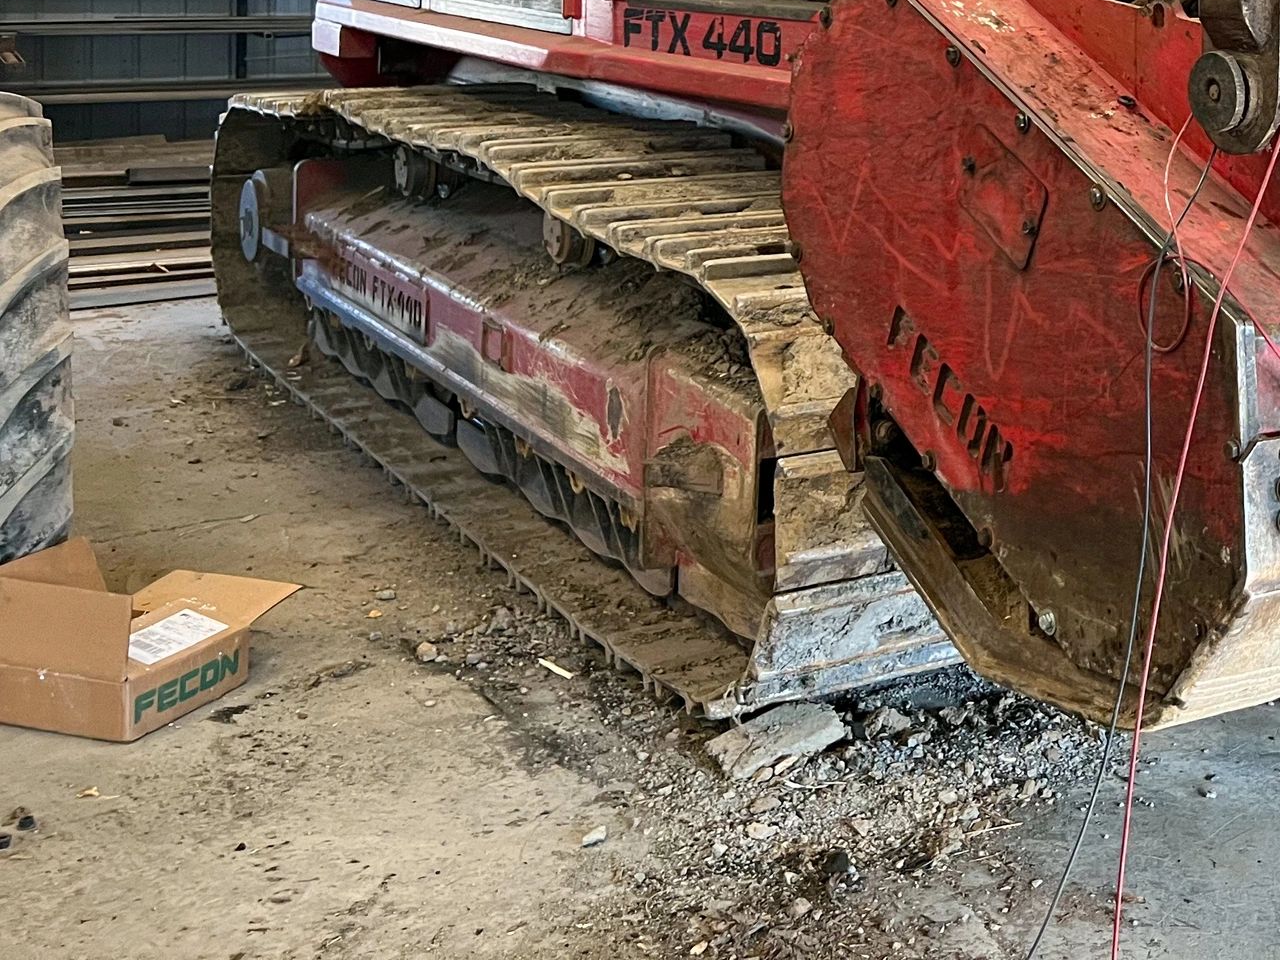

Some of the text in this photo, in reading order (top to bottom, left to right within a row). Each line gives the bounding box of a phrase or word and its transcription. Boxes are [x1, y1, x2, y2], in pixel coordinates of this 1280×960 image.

[624, 7, 782, 67] FTX 440
[887, 304, 1014, 494] FECON
[134, 648, 240, 725] FECON
